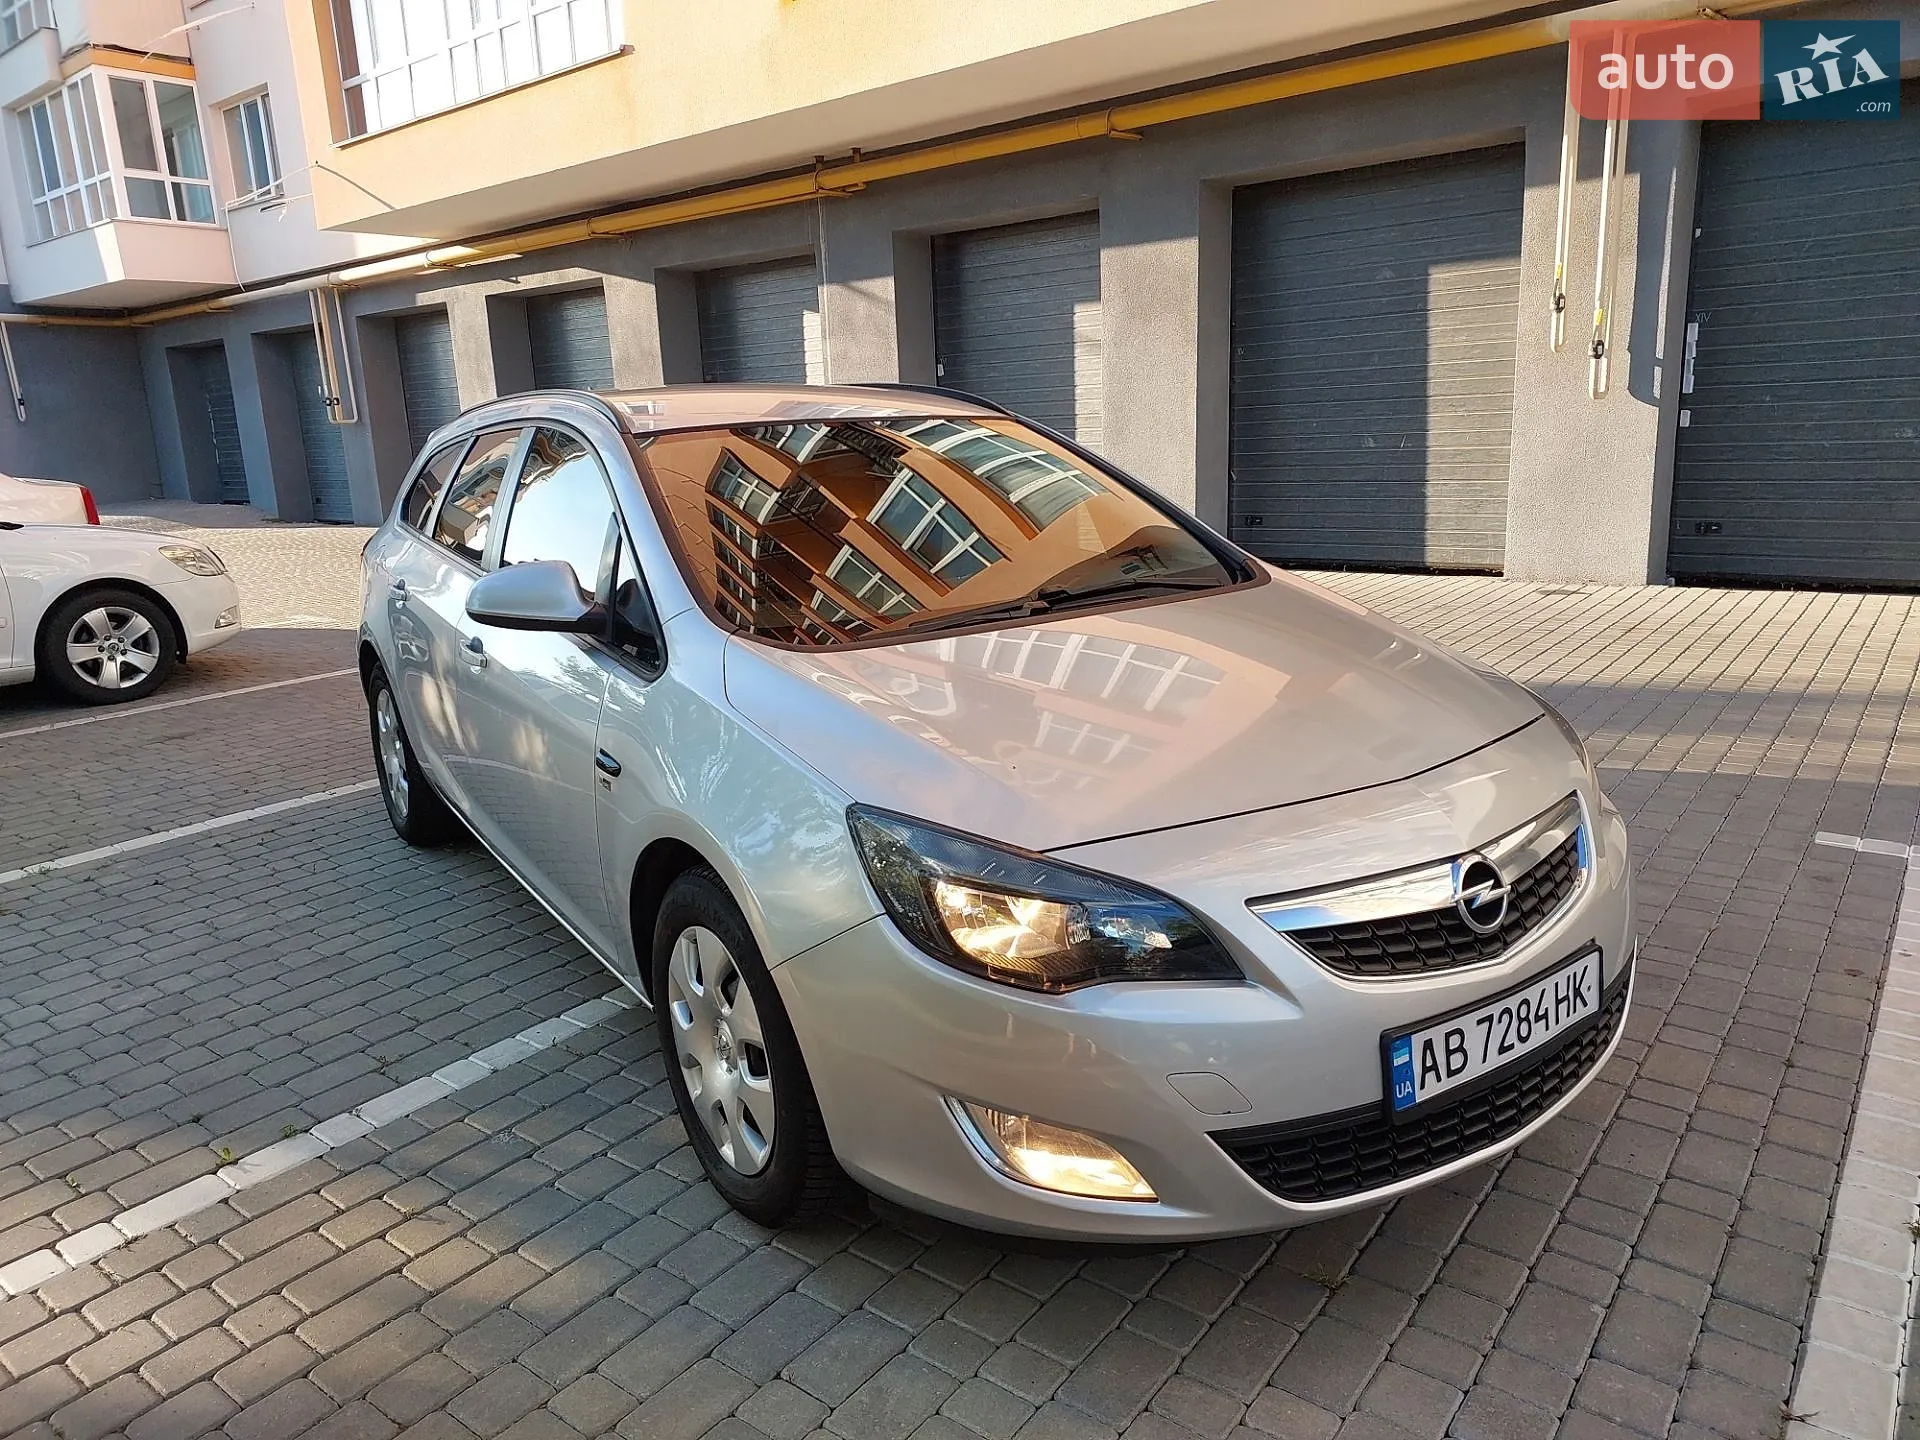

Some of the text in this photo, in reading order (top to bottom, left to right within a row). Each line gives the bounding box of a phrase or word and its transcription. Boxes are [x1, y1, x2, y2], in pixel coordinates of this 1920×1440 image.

[1420, 965, 1589, 1090] AB 7284 HK
[1396, 1081, 1413, 1098] UA
